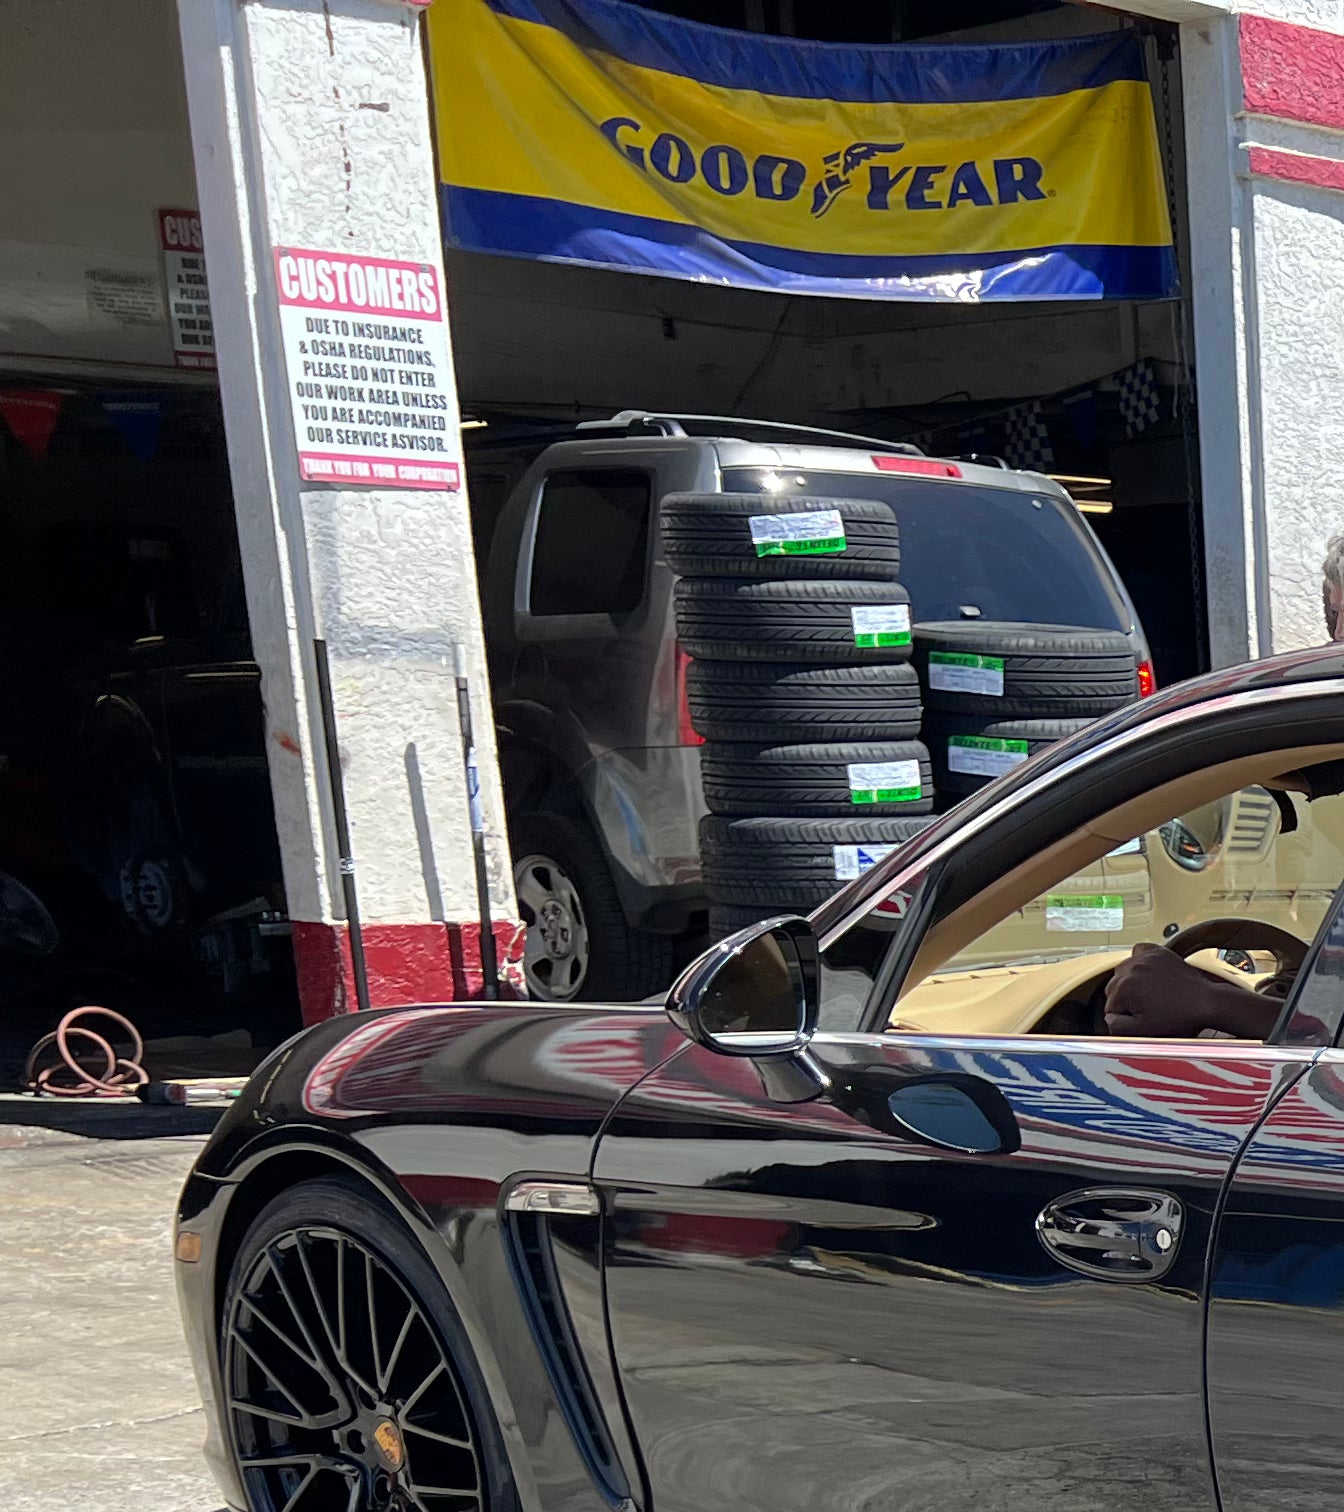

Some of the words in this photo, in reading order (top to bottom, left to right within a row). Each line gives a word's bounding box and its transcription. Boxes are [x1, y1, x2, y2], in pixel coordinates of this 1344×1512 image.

[279, 256, 437, 314] CUSTOMERS
[305, 317, 331, 334] DUE
[333, 320, 349, 336] TO
[352, 322, 423, 345] INSURANCE
[311, 340, 346, 358] OSHA
[304, 361, 349, 380] PLEASE
[351, 365, 368, 382] DO
[371, 367, 395, 384] NOT
[399, 370, 436, 388] ENTER
[296, 382, 323, 399] OUR
[326, 384, 365, 403] WORK
[368, 388, 400, 406] AREA
[402, 391, 447, 411] UNLESS
[302, 403, 328, 421] YOU
[331, 407, 355, 424] ARE
[358, 410, 446, 431] ACCOMPANIED
[307, 426, 334, 443] OUR
[336, 428, 389, 448] SERVICE
